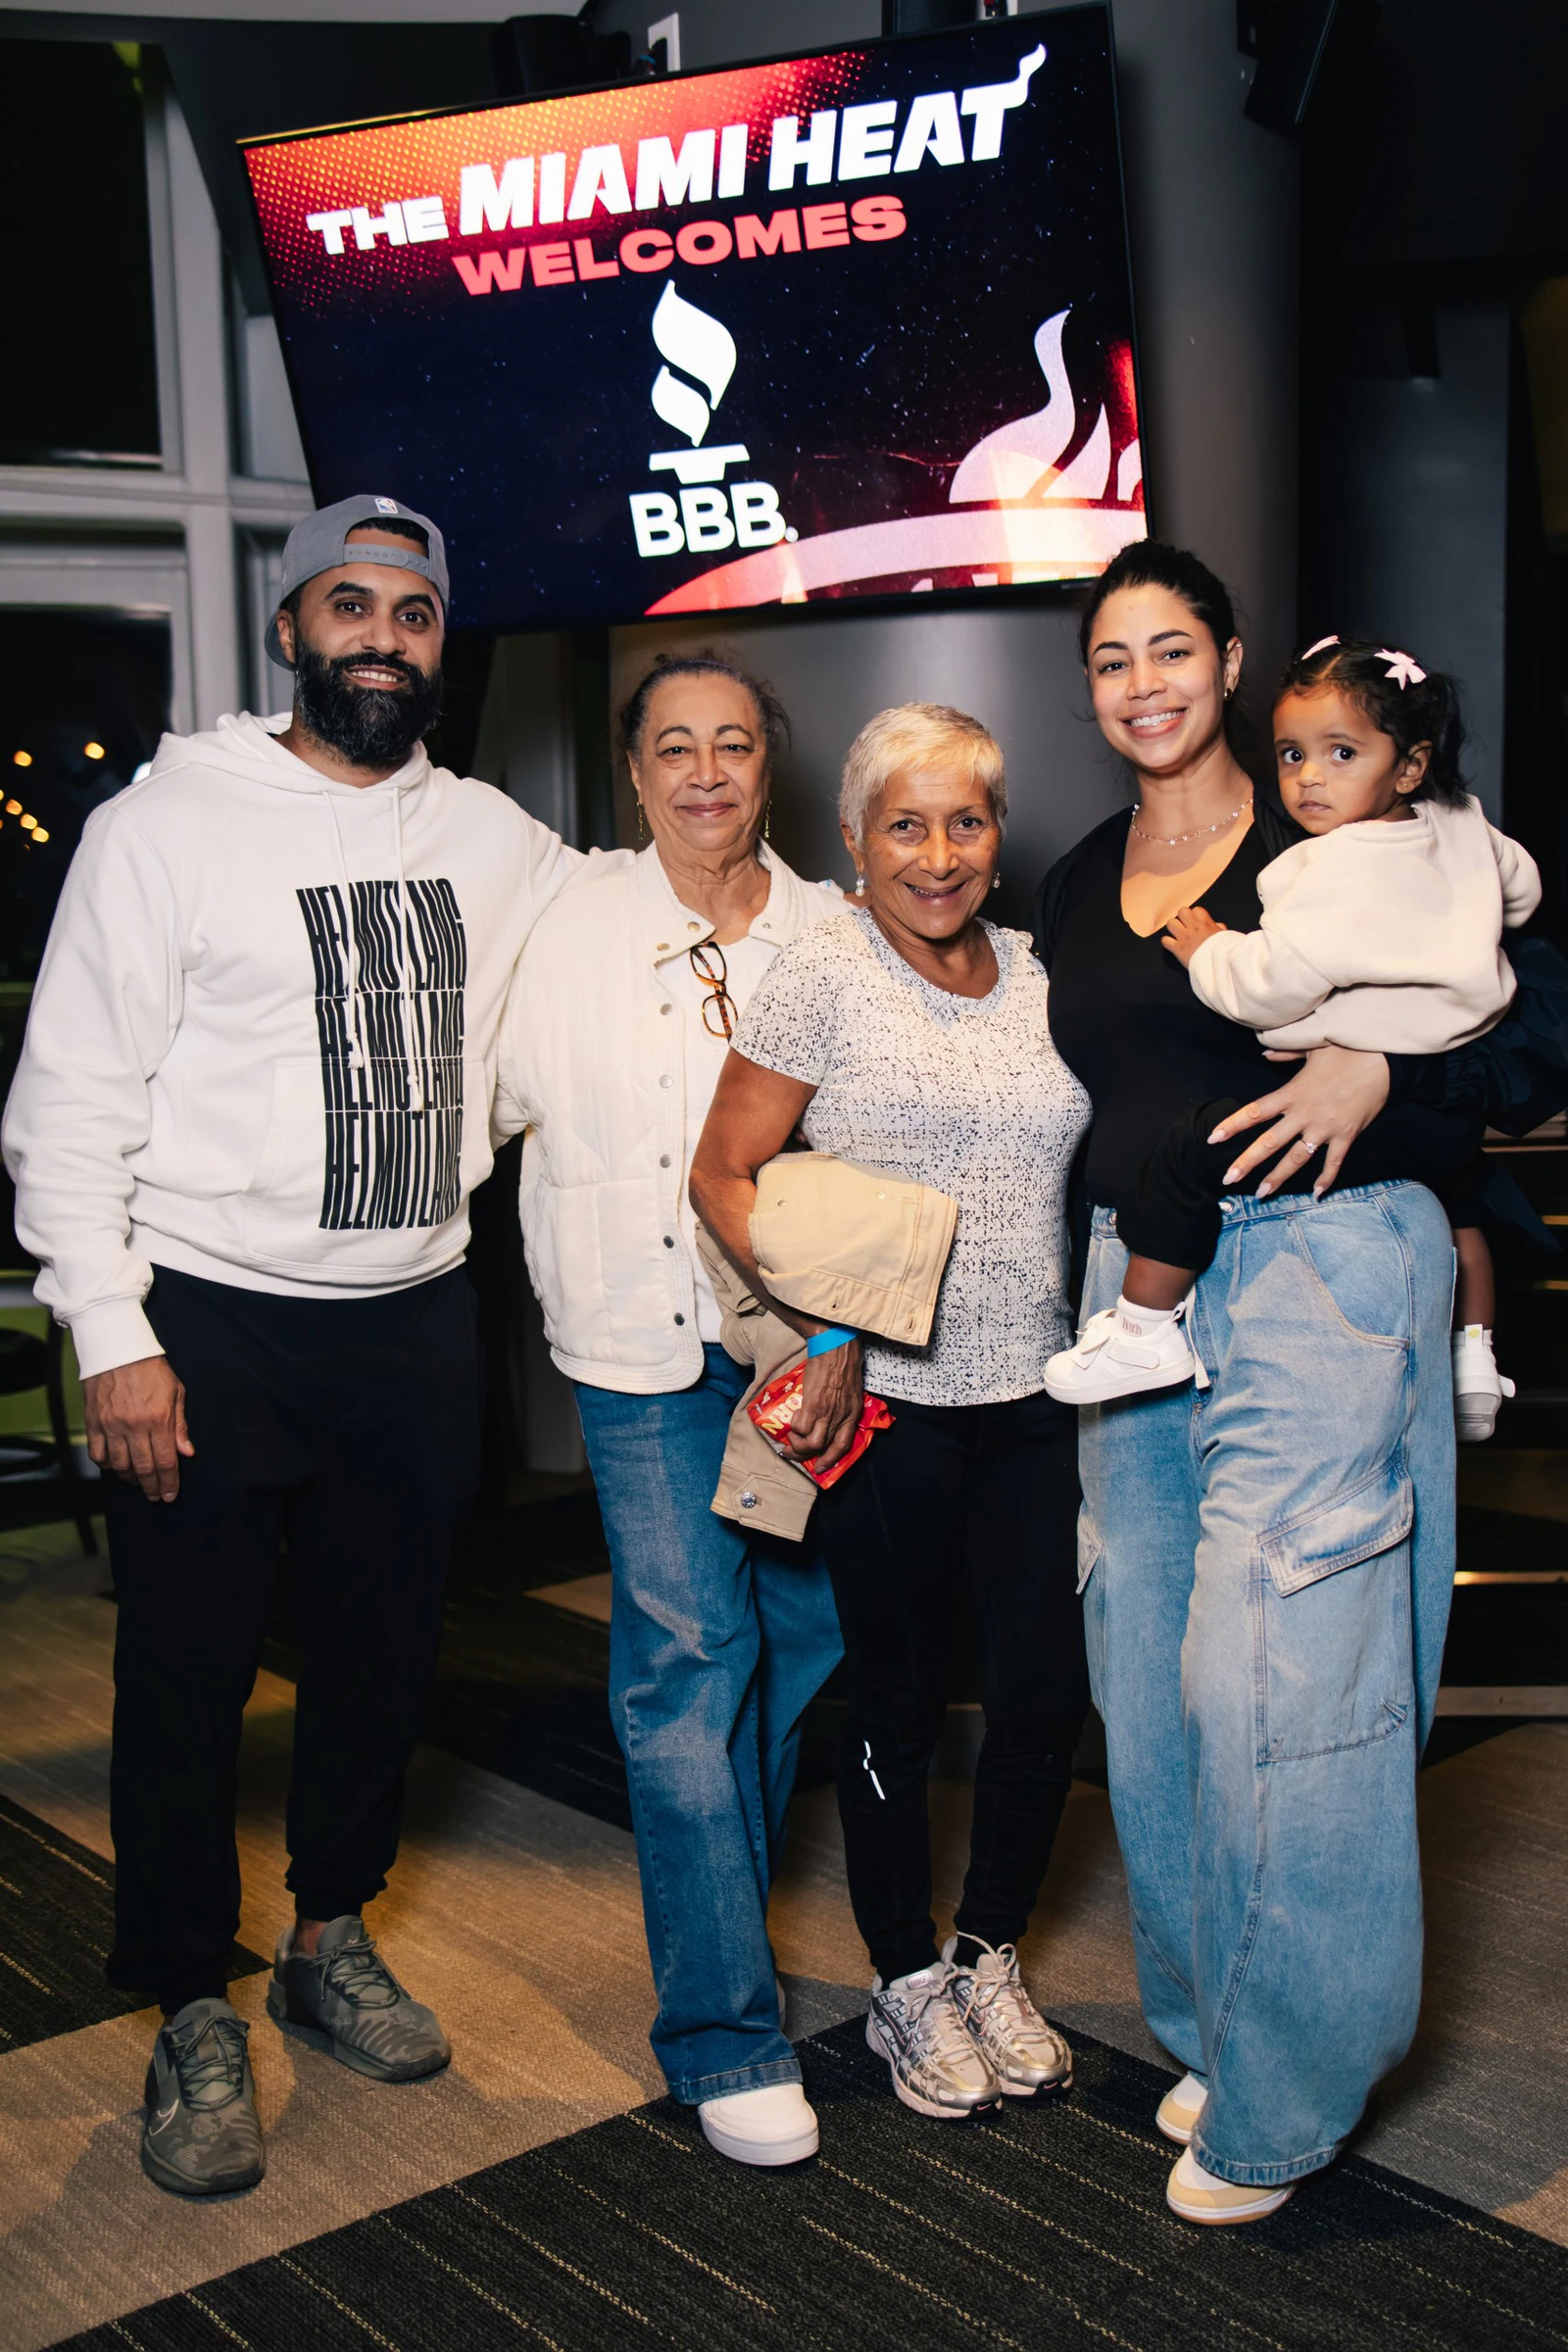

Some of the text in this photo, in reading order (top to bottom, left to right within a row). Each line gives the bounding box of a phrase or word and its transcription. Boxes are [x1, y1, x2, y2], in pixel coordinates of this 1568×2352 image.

[307, 44, 1047, 255] THE MIAMI HEAT
[452, 196, 907, 296] WELCOMES
